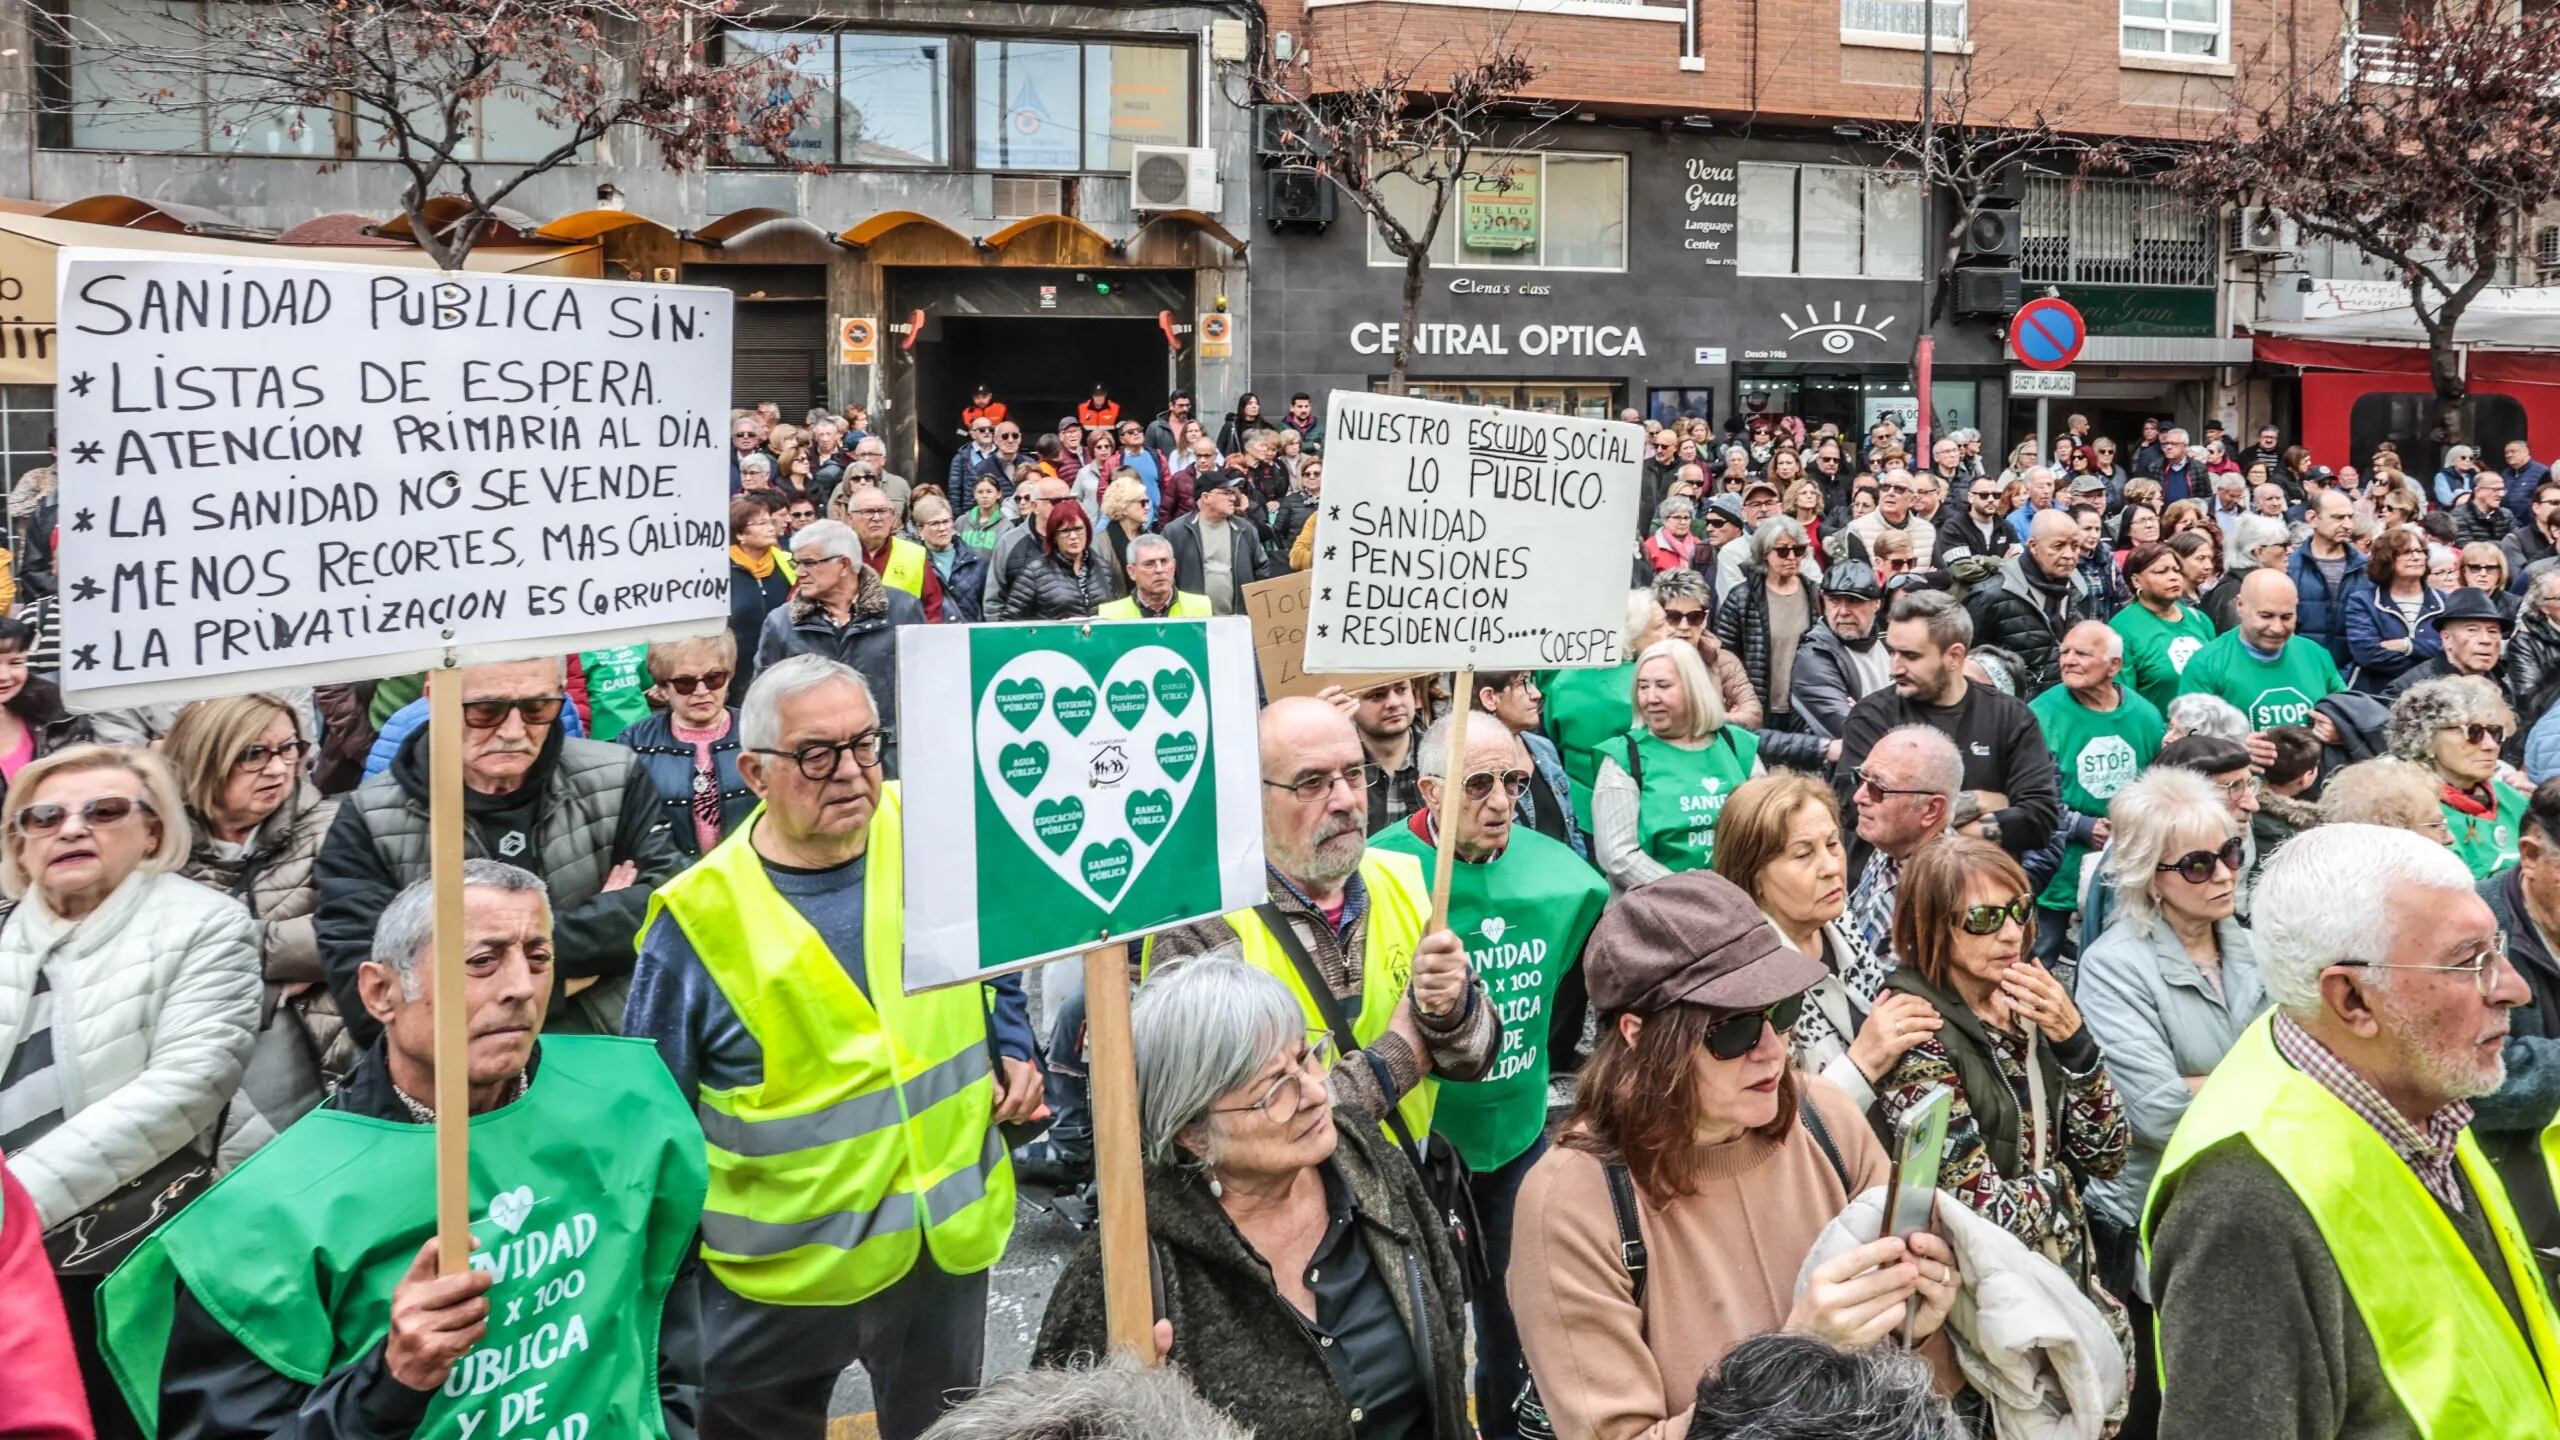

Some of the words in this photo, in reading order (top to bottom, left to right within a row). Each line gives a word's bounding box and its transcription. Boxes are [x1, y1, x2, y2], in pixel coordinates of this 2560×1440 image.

[1685, 158, 1735, 181] Vera
[1685, 183, 1738, 212] Gran
[1471, 206, 1529, 216] HELLO
[1685, 219, 1734, 234] Language
[1684, 238, 1720, 250] Center
[1519, 282, 1552, 296] class
[76, 270, 331, 336] SANIDAD
[371, 276, 582, 332] PUBLICA
[608, 294, 710, 342] SIN:
[2114, 292, 2177, 321] Gran
[1518, 323, 1647, 357] OPTICA
[1744, 350, 1768, 358] Desde
[1769, 350, 1788, 359] 1986
[112, 354, 325, 412] LISTAS
[361, 360, 430, 403] DE
[463, 360, 663, 407] ESPERA.
[599, 417, 641, 449] AL
[1338, 407, 1450, 446] NUESTRO
[1468, 419, 1548, 457] ESCUDO
[1553, 427, 1636, 464] SOCIAL
[1408, 455, 1440, 494] LO
[110, 495, 167, 538] LA
[192, 474, 379, 531] SANIDAD
[400, 470, 462, 516] NO
[472, 468, 530, 511] SE
[540, 464, 682, 504] VENDE.
[1349, 499, 1487, 543] SANIDAD
[112, 549, 291, 613] MENOS
[318, 526, 525, 592] RECORTES,
[542, 523, 620, 561] MAS
[1352, 541, 1531, 580] PENSIONES
[1346, 581, 1508, 610] EDUCACION
[112, 627, 170, 671] LA
[527, 584, 568, 616] ES
[1540, 628, 1618, 664] COESPE
[996, 692, 1044, 702] TRANSPORTE
[1003, 701, 1039, 712] PÚBLICO
[1057, 700, 1093, 710] VIVIENDA
[1110, 692, 1146, 702] Pensiones
[1111, 701, 1146, 713] Públicas
[1161, 692, 1189, 701] PÚBLICA
[1059, 708, 1091, 719] PÚBLICA
[2257, 702, 2308, 725] STOP
[1013, 757, 1036, 767] AGUA
[1160, 753, 1195, 764] PÚBLICAS
[2084, 751, 2131, 773] STOP
[1005, 766, 1043, 779] PÚBLICA
[1035, 810, 1083, 826] EDUCACIÓN
[1131, 814, 1166, 826] PÚBLICA
[1134, 805, 1163, 815] BANCA
[1688, 814, 1713, 827] 100
[1041, 822, 1078, 836] PÚBLICA
[1087, 855, 1128, 871] SANIDAD
[1089, 866, 1127, 882] PÚBLICA
[1510, 970, 1543, 991] 100
[1491, 995, 1542, 1027] LICA
[1503, 1027, 1525, 1054] DE
[1481, 1045, 1538, 1083] LIDAD
[468, 1212, 599, 1285] NIDAD
[503, 1296, 524, 1327] x
[532, 1268, 587, 1316] 100
[443, 1313, 590, 1398] ÚBLICA
[456, 1409, 487, 1440] Y
[497, 1381, 549, 1438] DE
